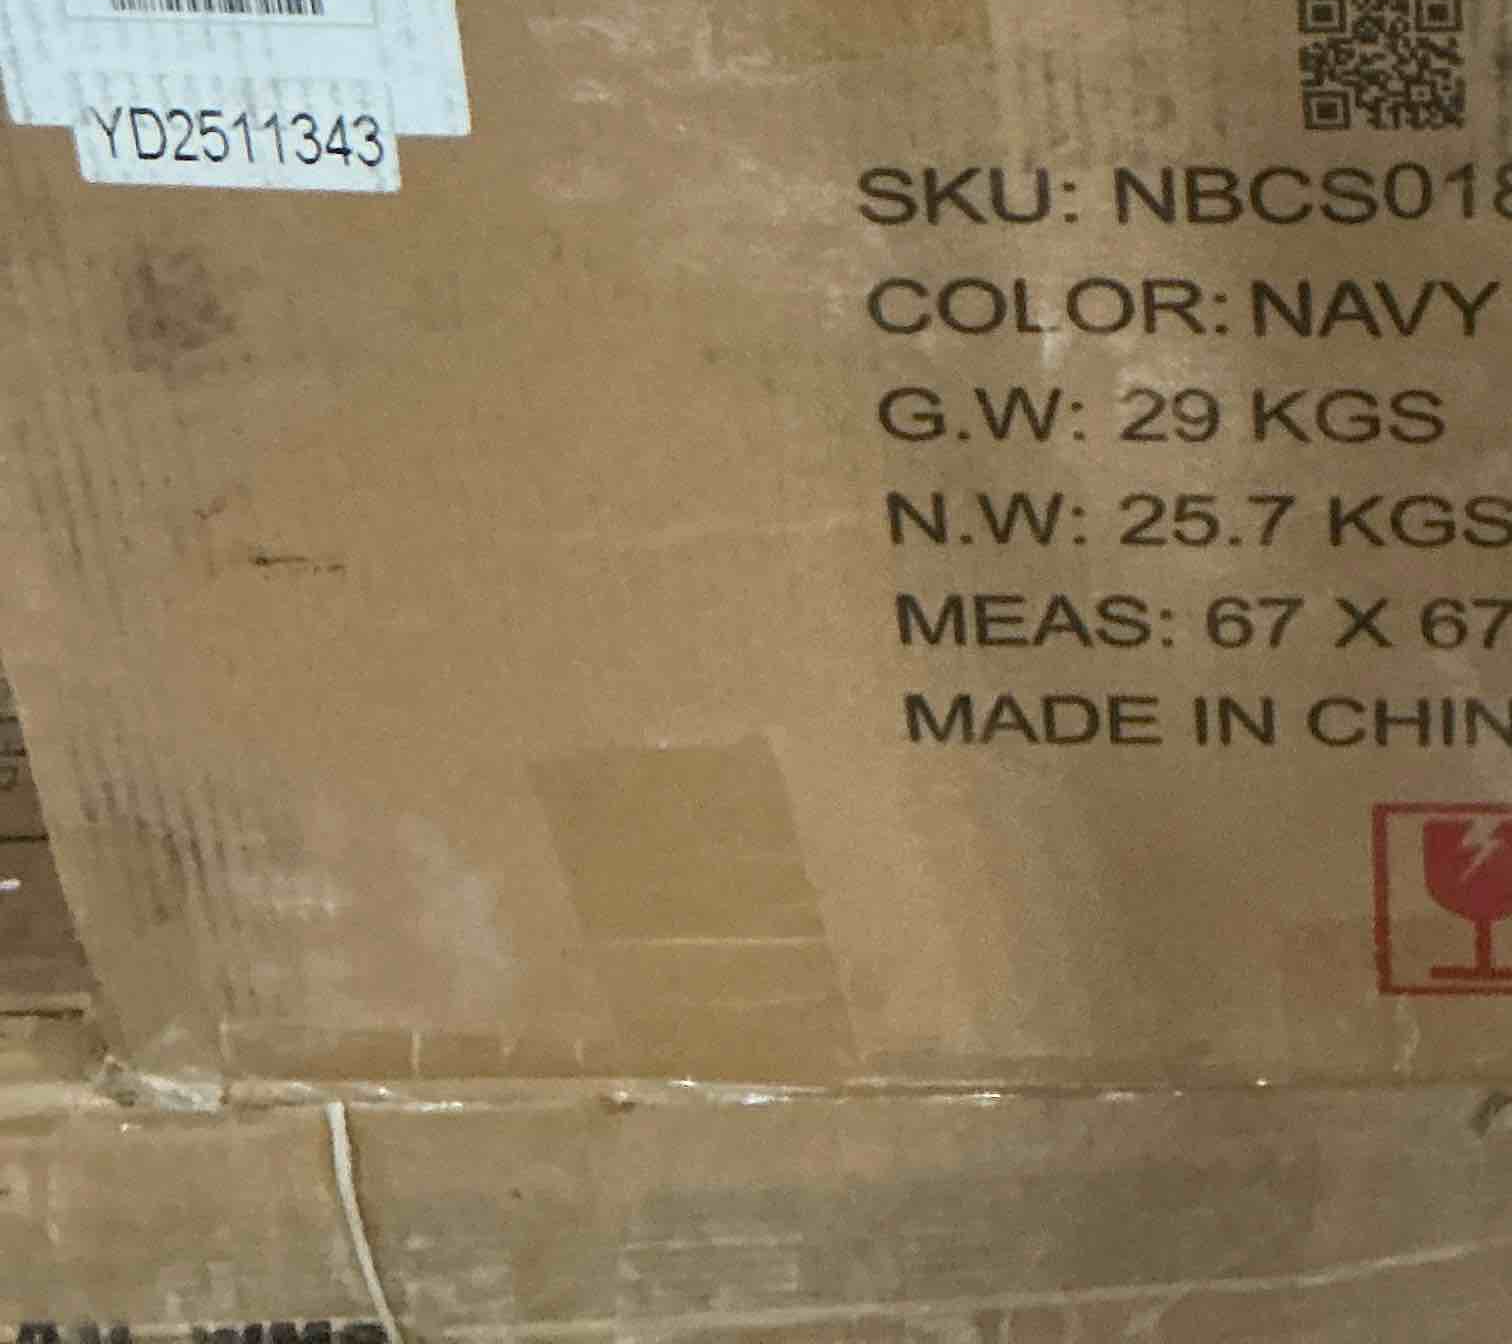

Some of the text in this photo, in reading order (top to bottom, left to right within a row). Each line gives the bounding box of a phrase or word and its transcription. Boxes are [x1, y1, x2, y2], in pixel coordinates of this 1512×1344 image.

[90, 105, 385, 169] YD2511343
[857, 166, 1079, 227] SKU:
[866, 277, 1501, 338] COLOR: NAVY
[877, 386, 1446, 444] G.W: 29 KGS
[886, 491, 1087, 546] N.W:
[1119, 493, 1297, 548] 25.7
[895, 593, 1174, 648] MEAS:
[1206, 596, 1304, 649] 67
[1335, 598, 1393, 649] X
[903, 693, 1163, 746] MADE
[1194, 695, 1275, 746] IN
